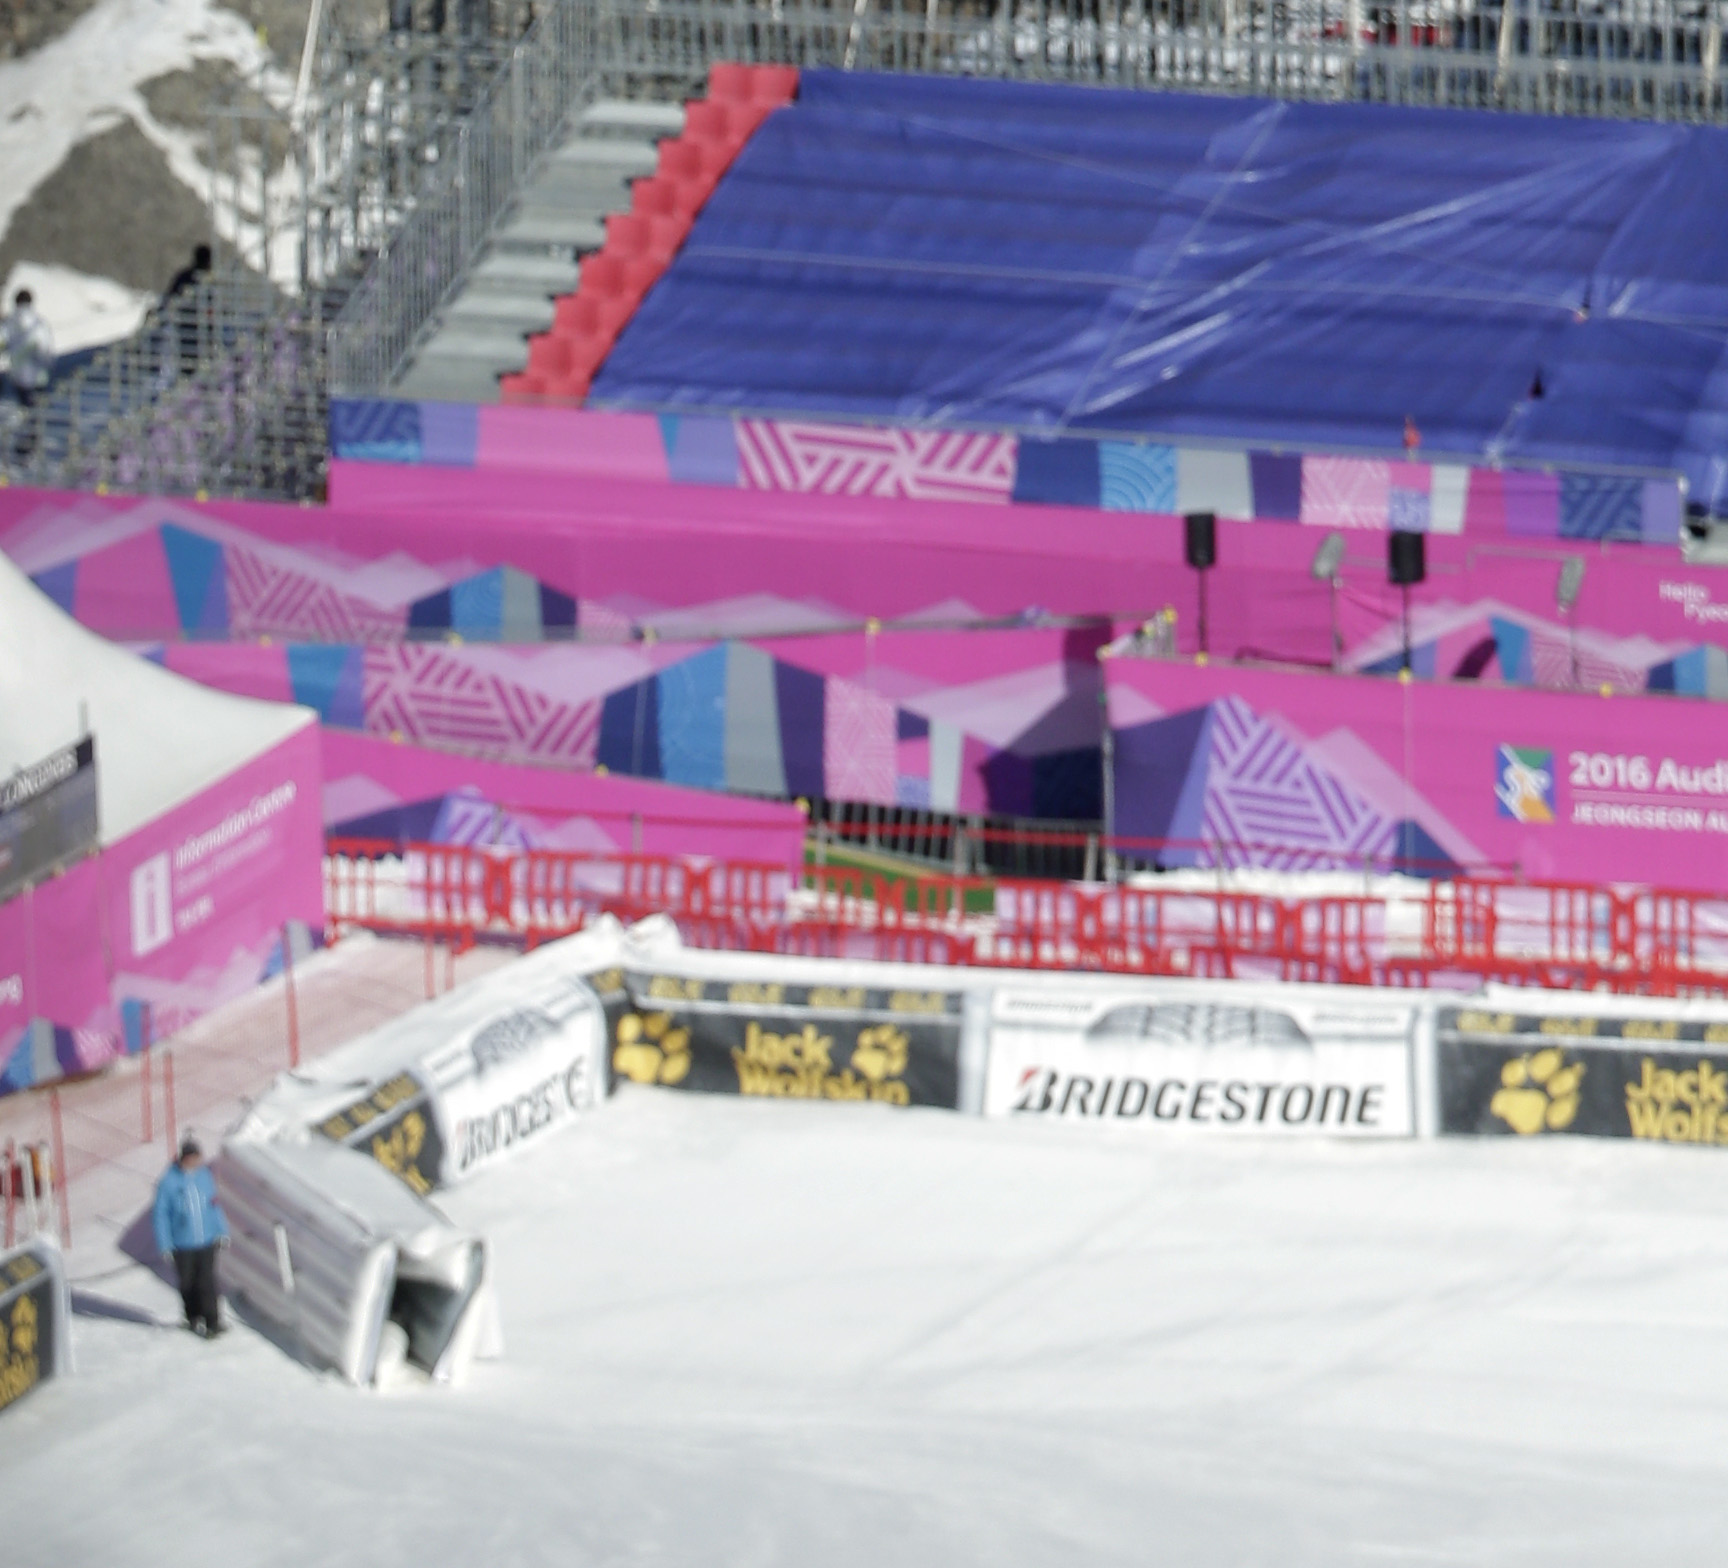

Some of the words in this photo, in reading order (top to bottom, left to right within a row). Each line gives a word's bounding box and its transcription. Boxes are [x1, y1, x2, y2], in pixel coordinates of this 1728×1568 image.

[1569, 750, 1652, 790] 2016
[1571, 801, 1701, 831] JEONGSEON
[731, 1021, 834, 1064] Jack
[1013, 1066, 1386, 1126] BRIDGESTONE
[1625, 1058, 1728, 1104] Jack
